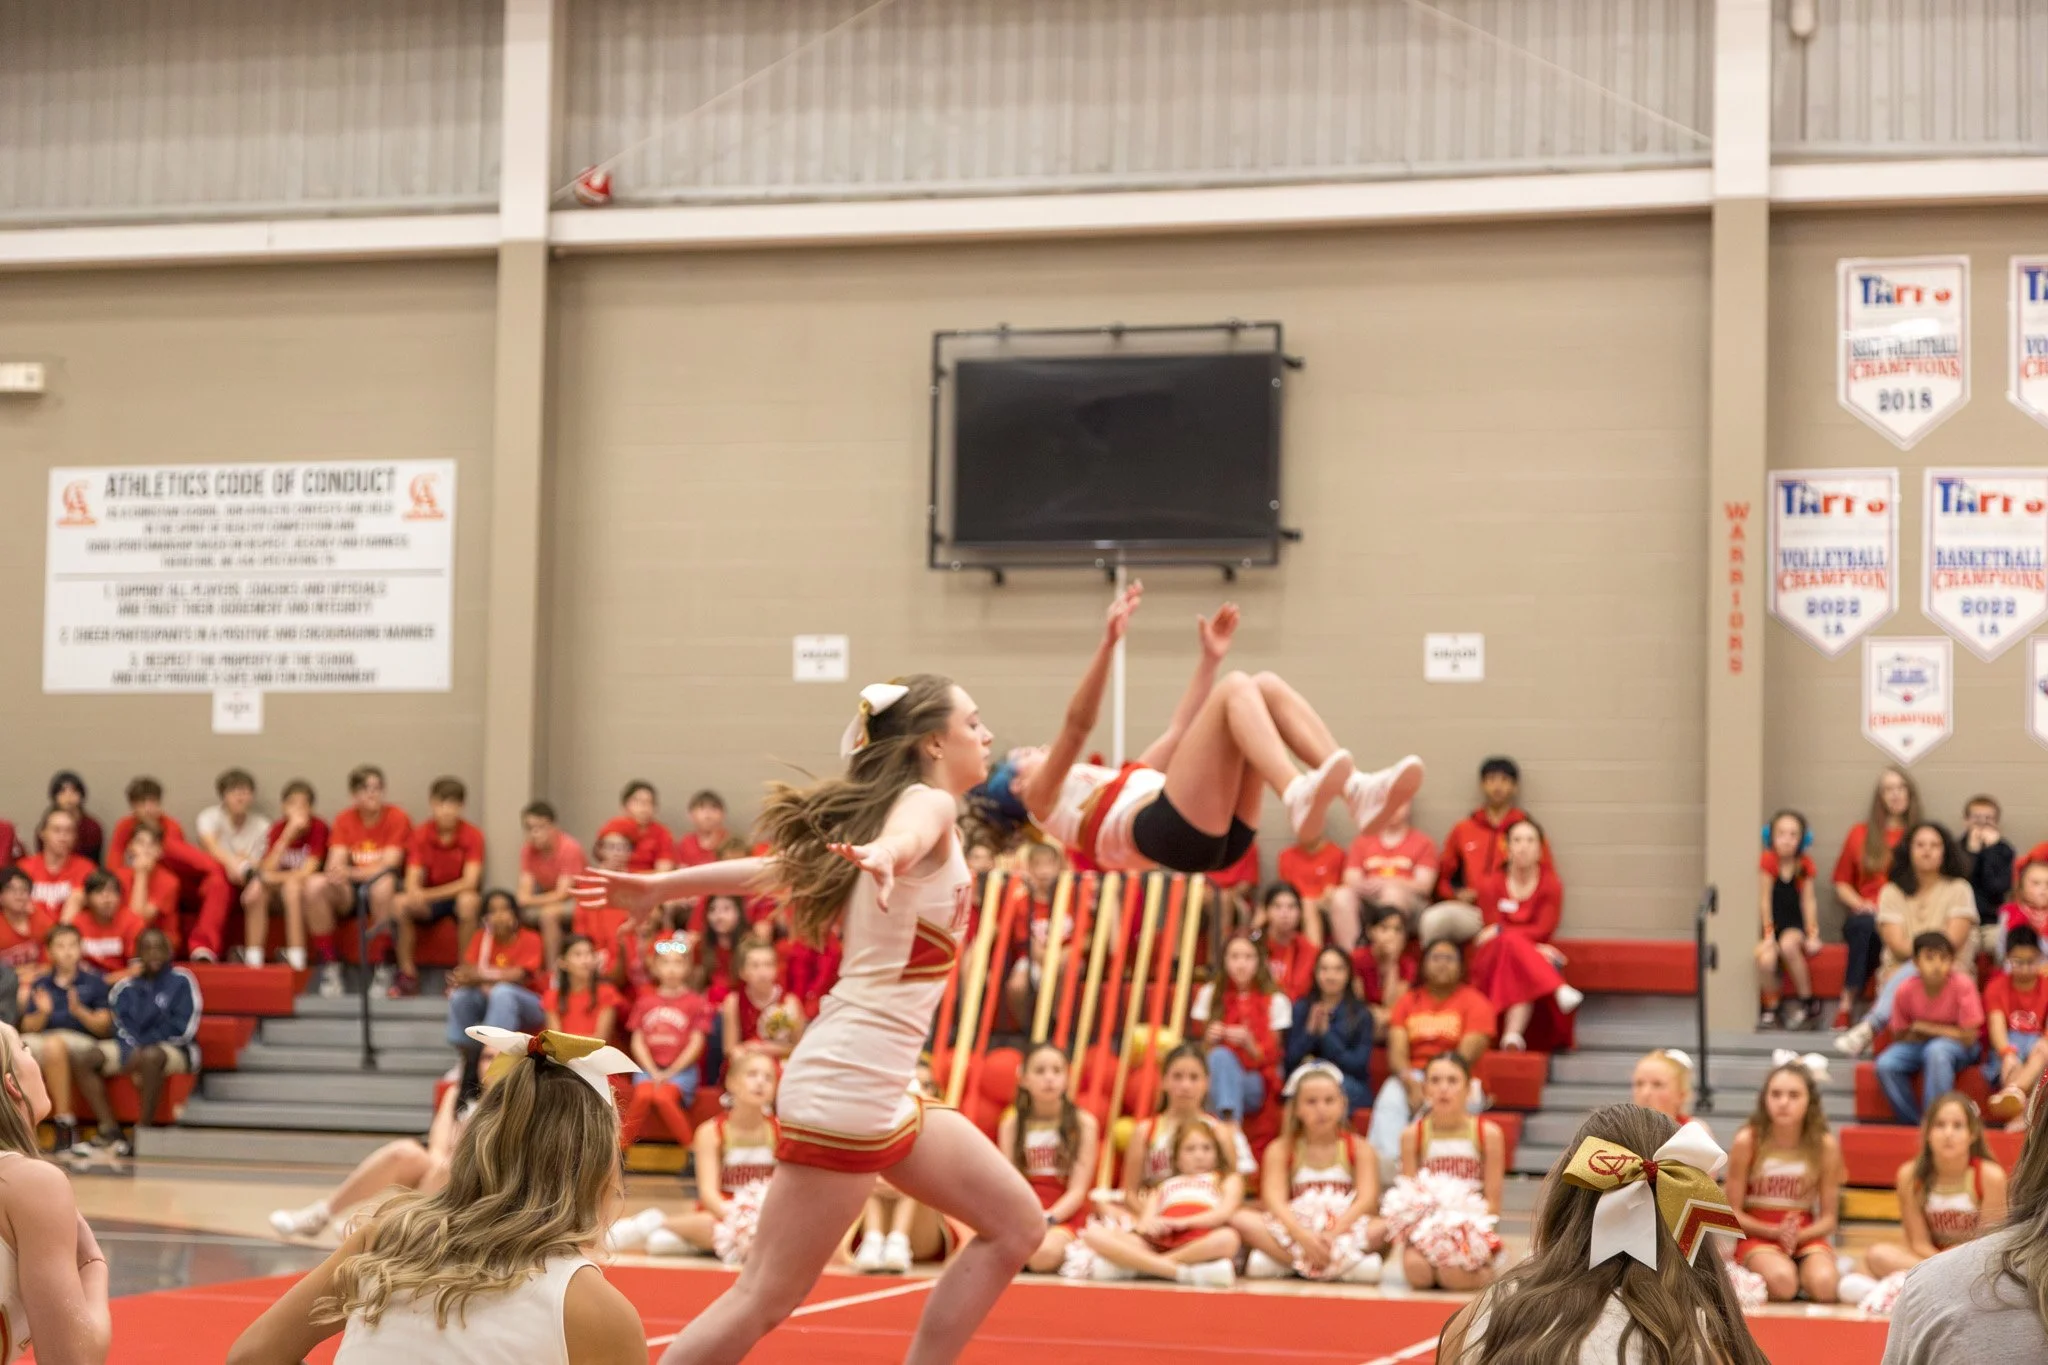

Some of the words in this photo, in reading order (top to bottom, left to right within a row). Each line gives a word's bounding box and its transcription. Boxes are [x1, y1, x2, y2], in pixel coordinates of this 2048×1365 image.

[1850, 357, 1960, 380] CHAMPIONS
[103, 471, 209, 497] ATHLETICS
[215, 470, 265, 497] CODE
[272, 469, 296, 496] OF
[302, 468, 396, 495] CONDUCT
[1780, 546, 1886, 568] VOLLEYBALL
[1935, 546, 2042, 568] BASKETBALL
[1724, 502, 1750, 673] WARRIORS
[1933, 569, 2046, 592] CHAMPIONS
